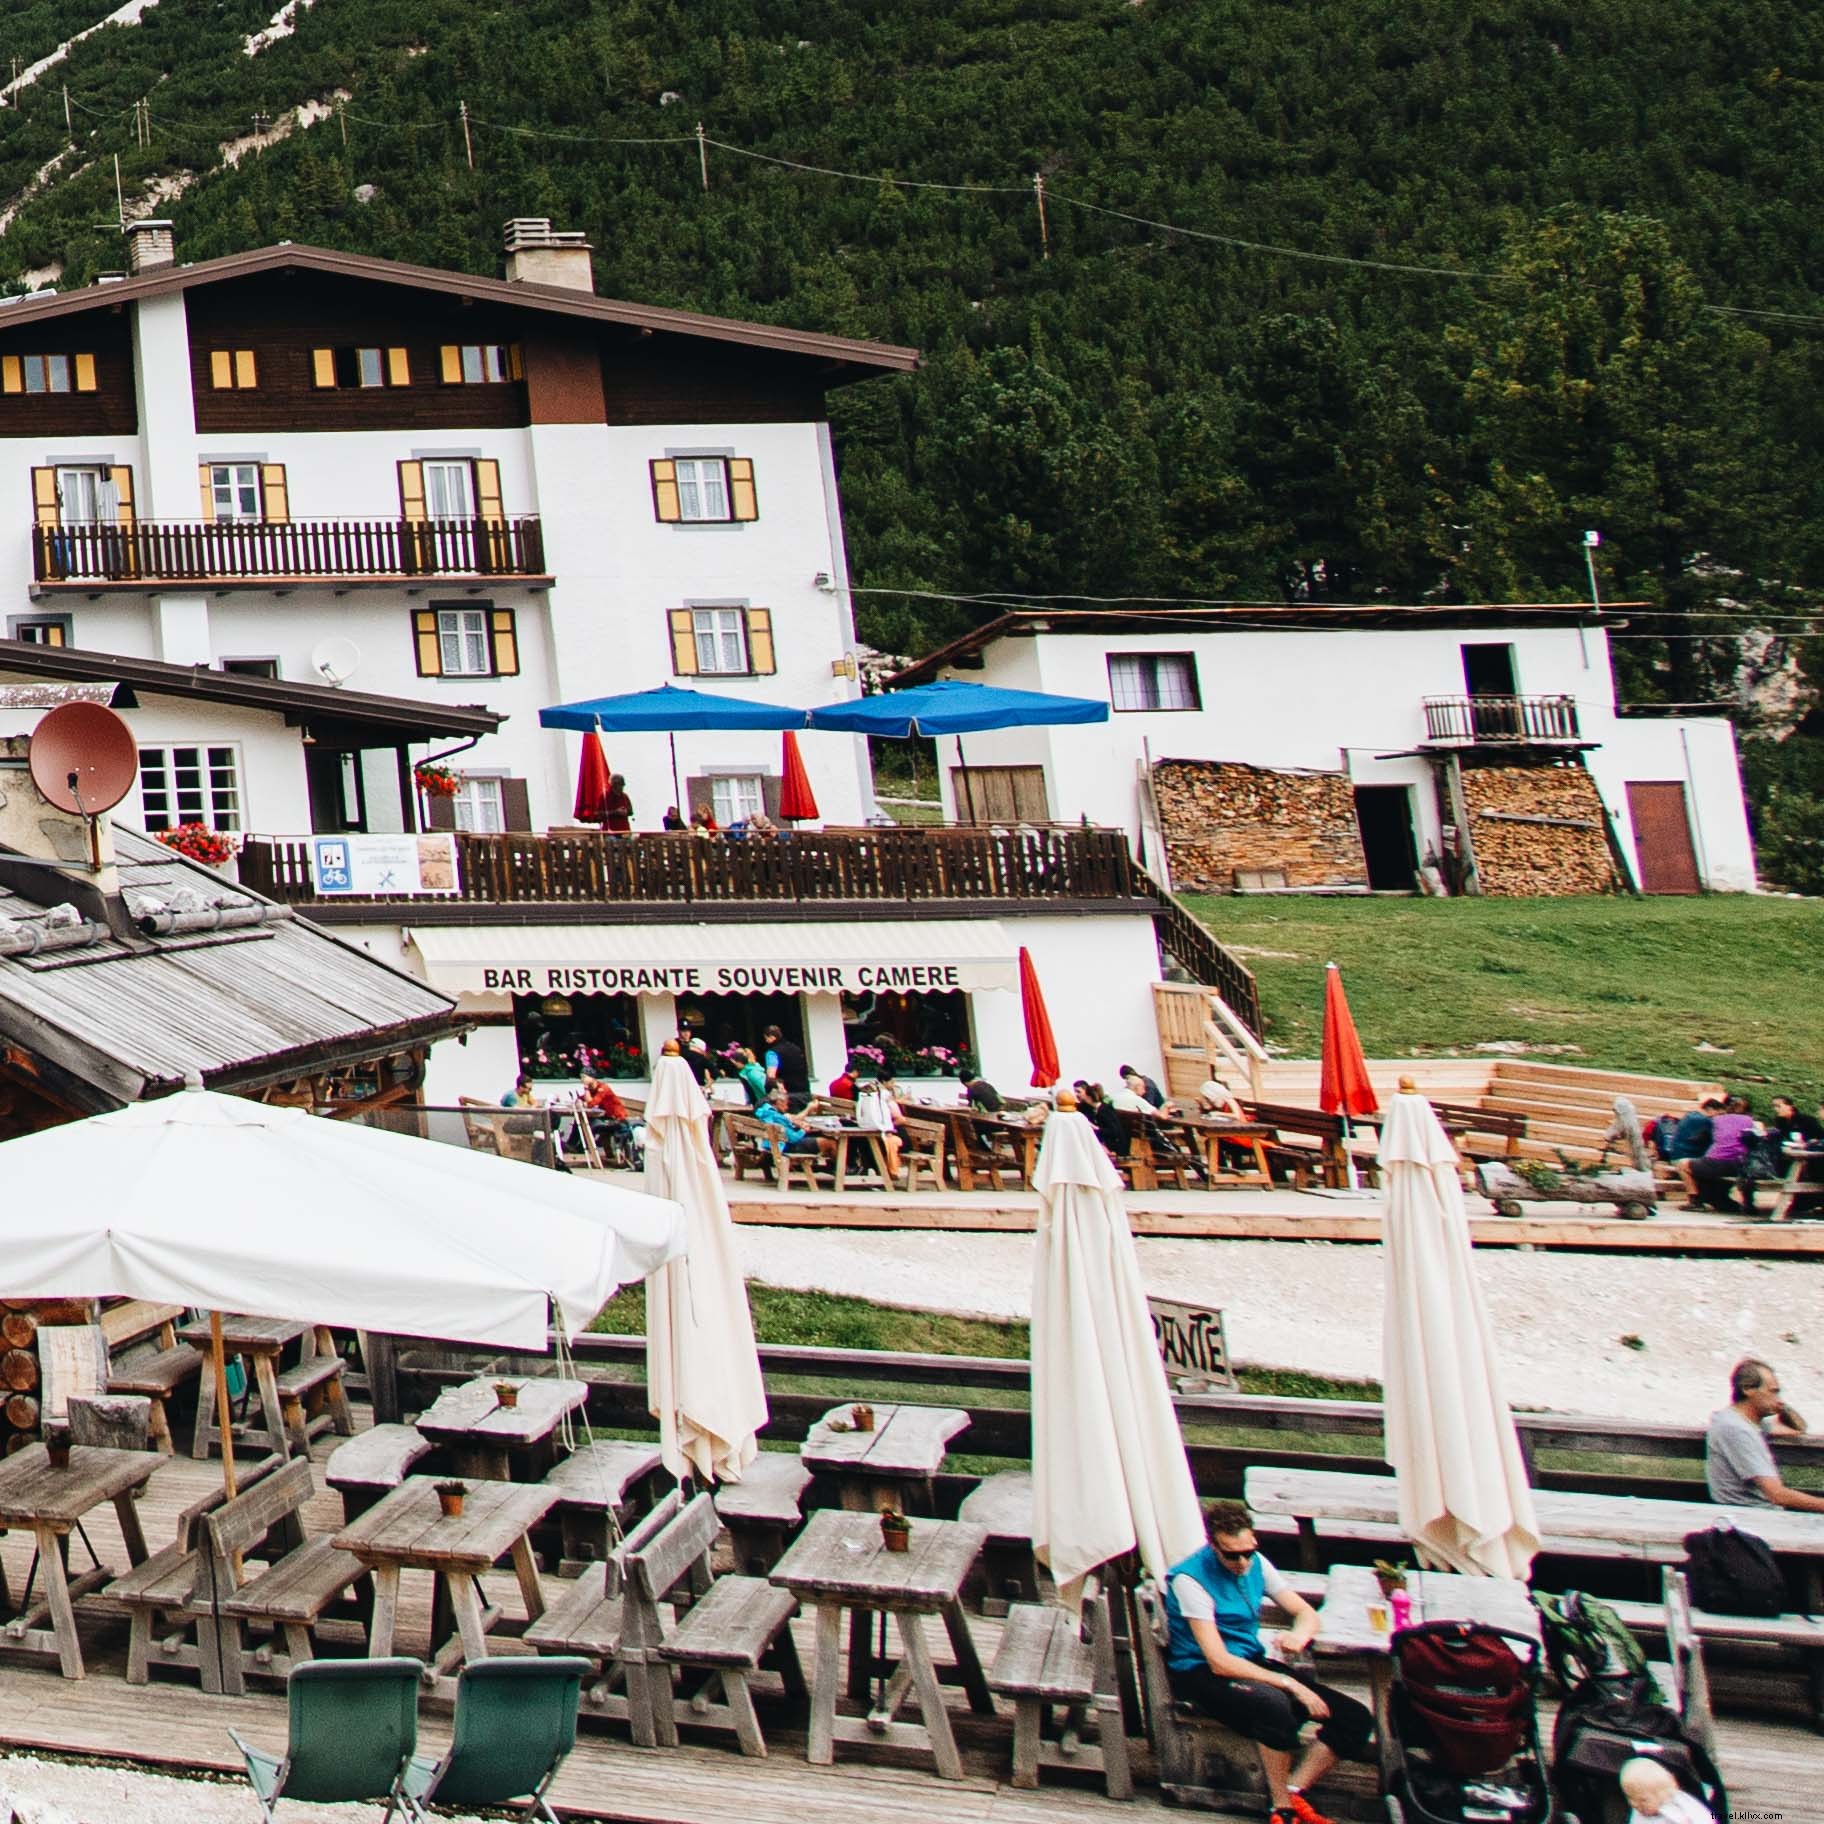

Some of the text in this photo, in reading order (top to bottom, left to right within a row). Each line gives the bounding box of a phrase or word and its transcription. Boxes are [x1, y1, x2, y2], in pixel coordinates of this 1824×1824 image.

[483, 965, 960, 989] BAR RISTORANTE SOUVENIR CAMERE
